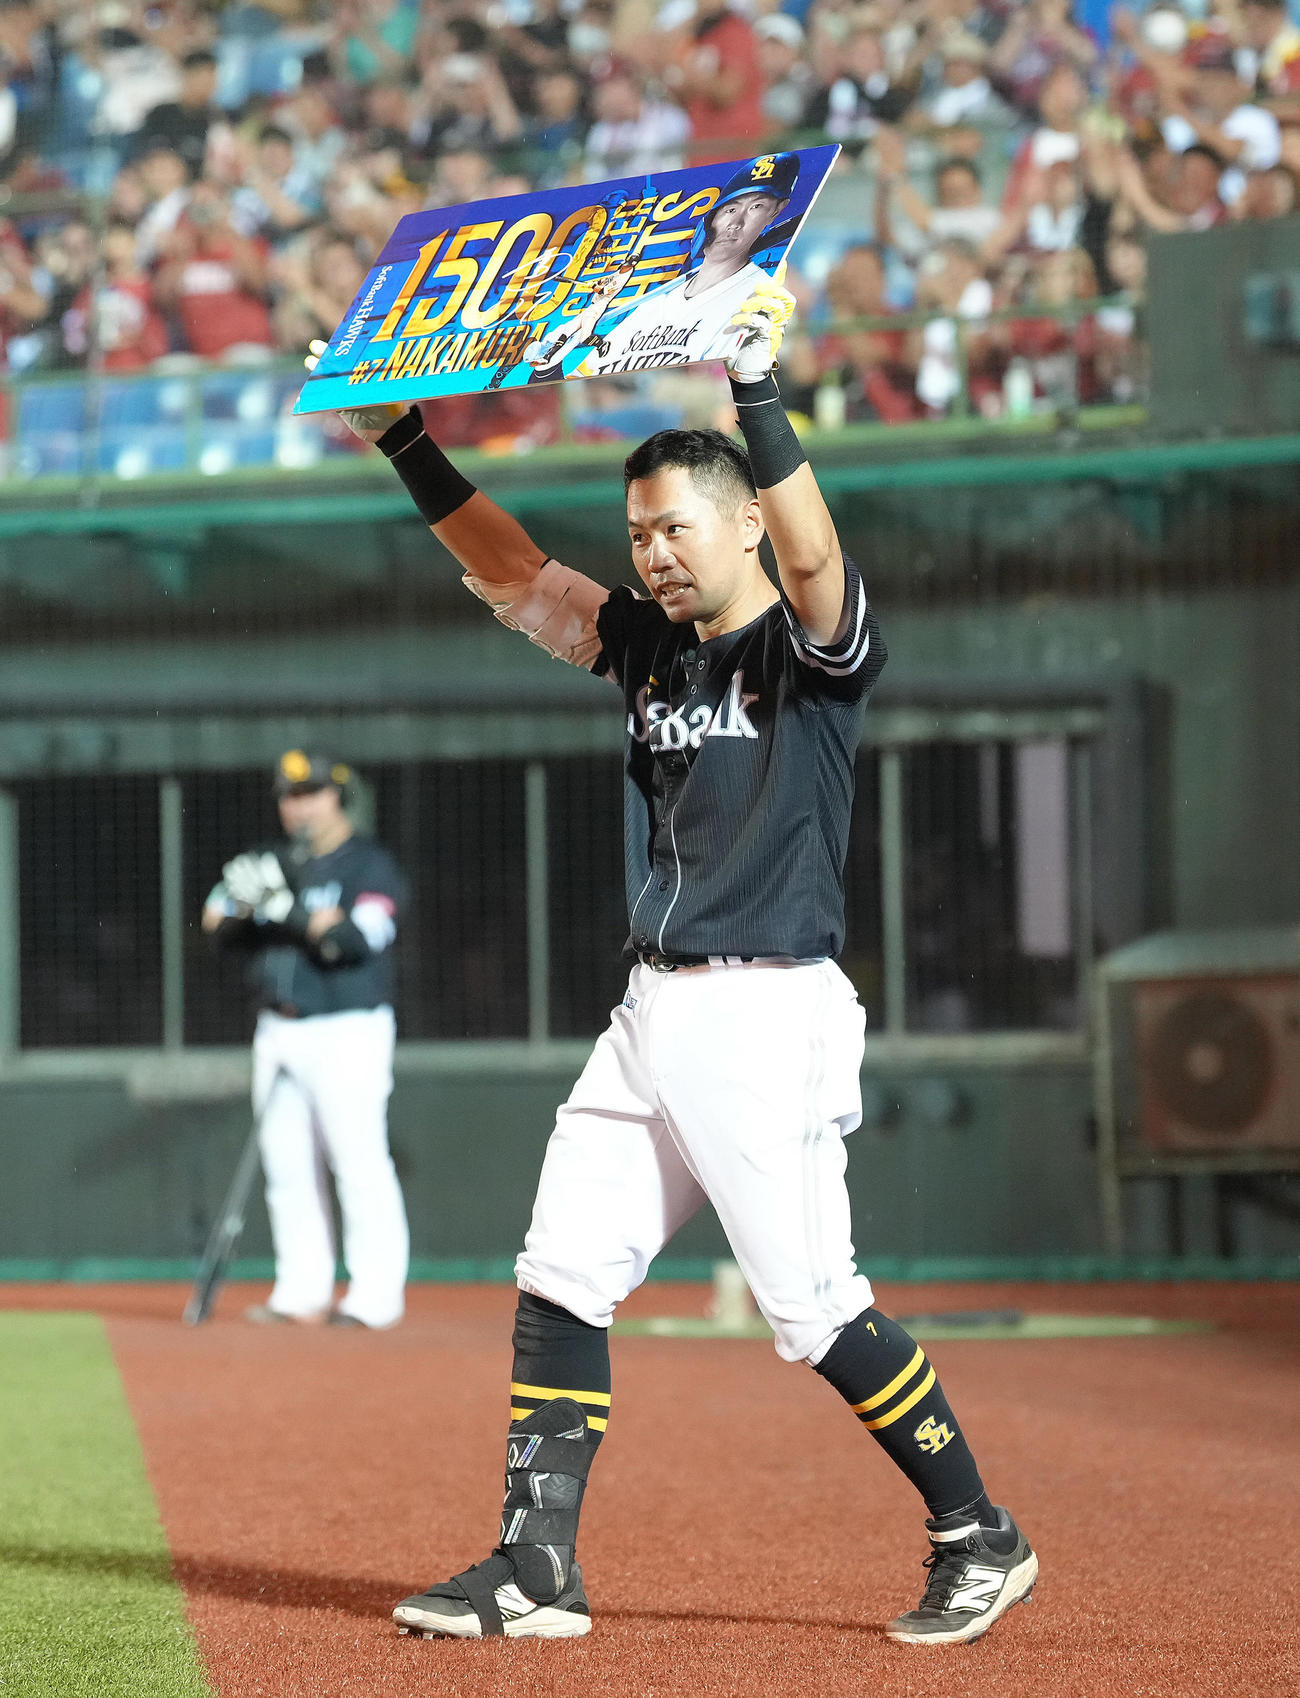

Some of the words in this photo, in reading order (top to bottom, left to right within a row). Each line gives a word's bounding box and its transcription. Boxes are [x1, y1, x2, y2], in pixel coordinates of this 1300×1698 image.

[369, 204, 607, 343] 1500
[606, 187, 721, 309] HITS
[363, 265, 393, 307] SoftBank
[334, 304, 374, 357] HAWKS
[348, 359, 385, 386] #7
[377, 321, 548, 382] NAKAMURA
[866, 1321, 878, 1337] 7
[942, 1564, 1007, 1615] N
